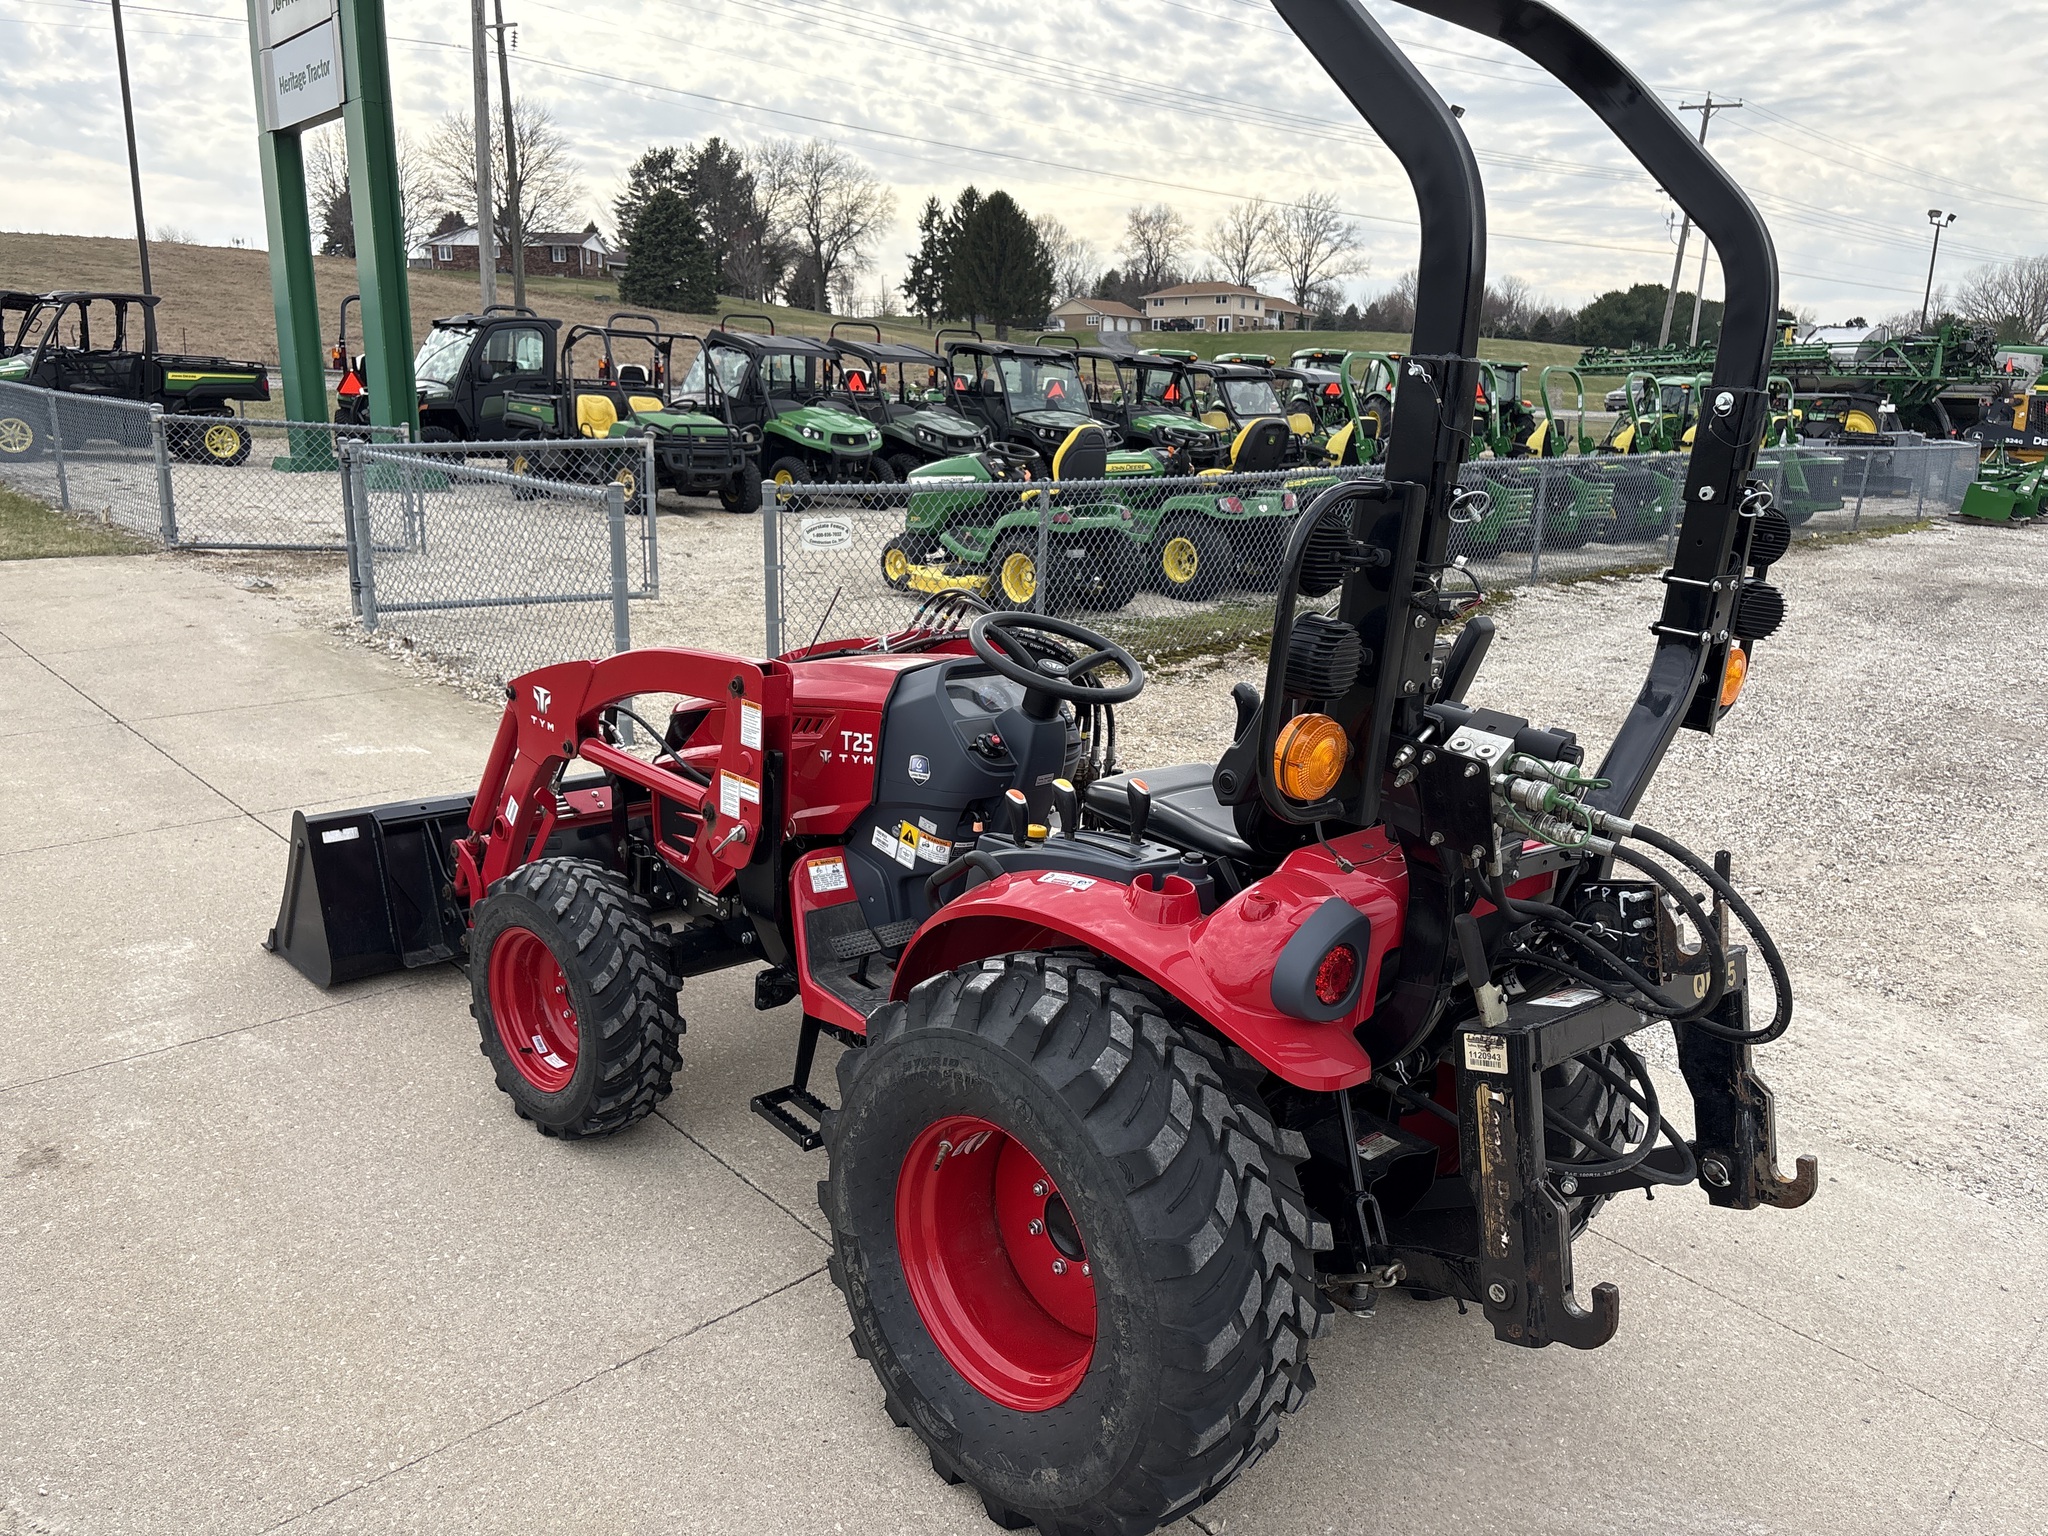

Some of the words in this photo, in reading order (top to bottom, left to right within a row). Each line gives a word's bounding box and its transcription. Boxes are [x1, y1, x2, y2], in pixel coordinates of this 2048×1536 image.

[279, 71, 307, 95] Heritage
[306, 60, 330, 83] Tractor
[806, 524, 829, 534] Interstate
[830, 523, 845, 531] Fence
[531, 715, 555, 732] TYM
[840, 730, 873, 753] T25
[839, 753, 874, 765] TYM
[1469, 1050, 1502, 1061] 1120943
